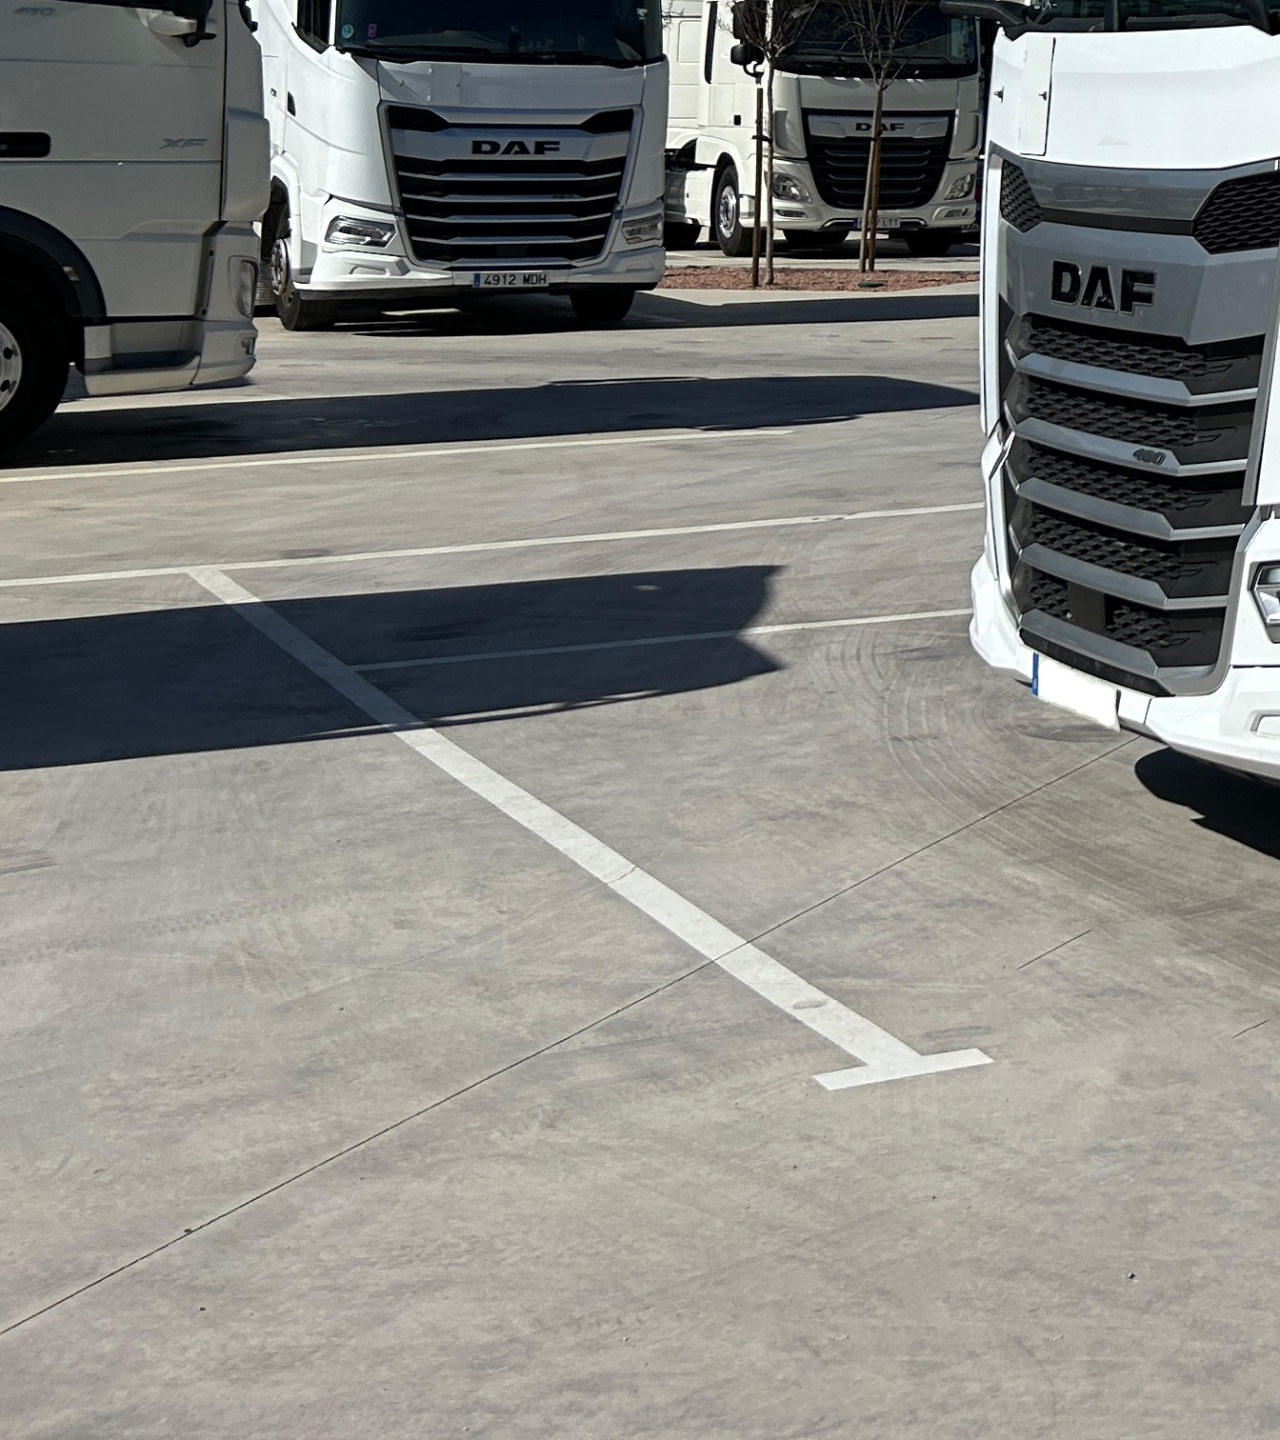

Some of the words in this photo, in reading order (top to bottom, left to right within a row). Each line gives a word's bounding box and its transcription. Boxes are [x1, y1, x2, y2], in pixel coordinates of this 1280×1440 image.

[159, 137, 208, 150] XF
[471, 140, 561, 156] DAF
[483, 273, 517, 286] 4912
[1050, 259, 1158, 315] DAF
